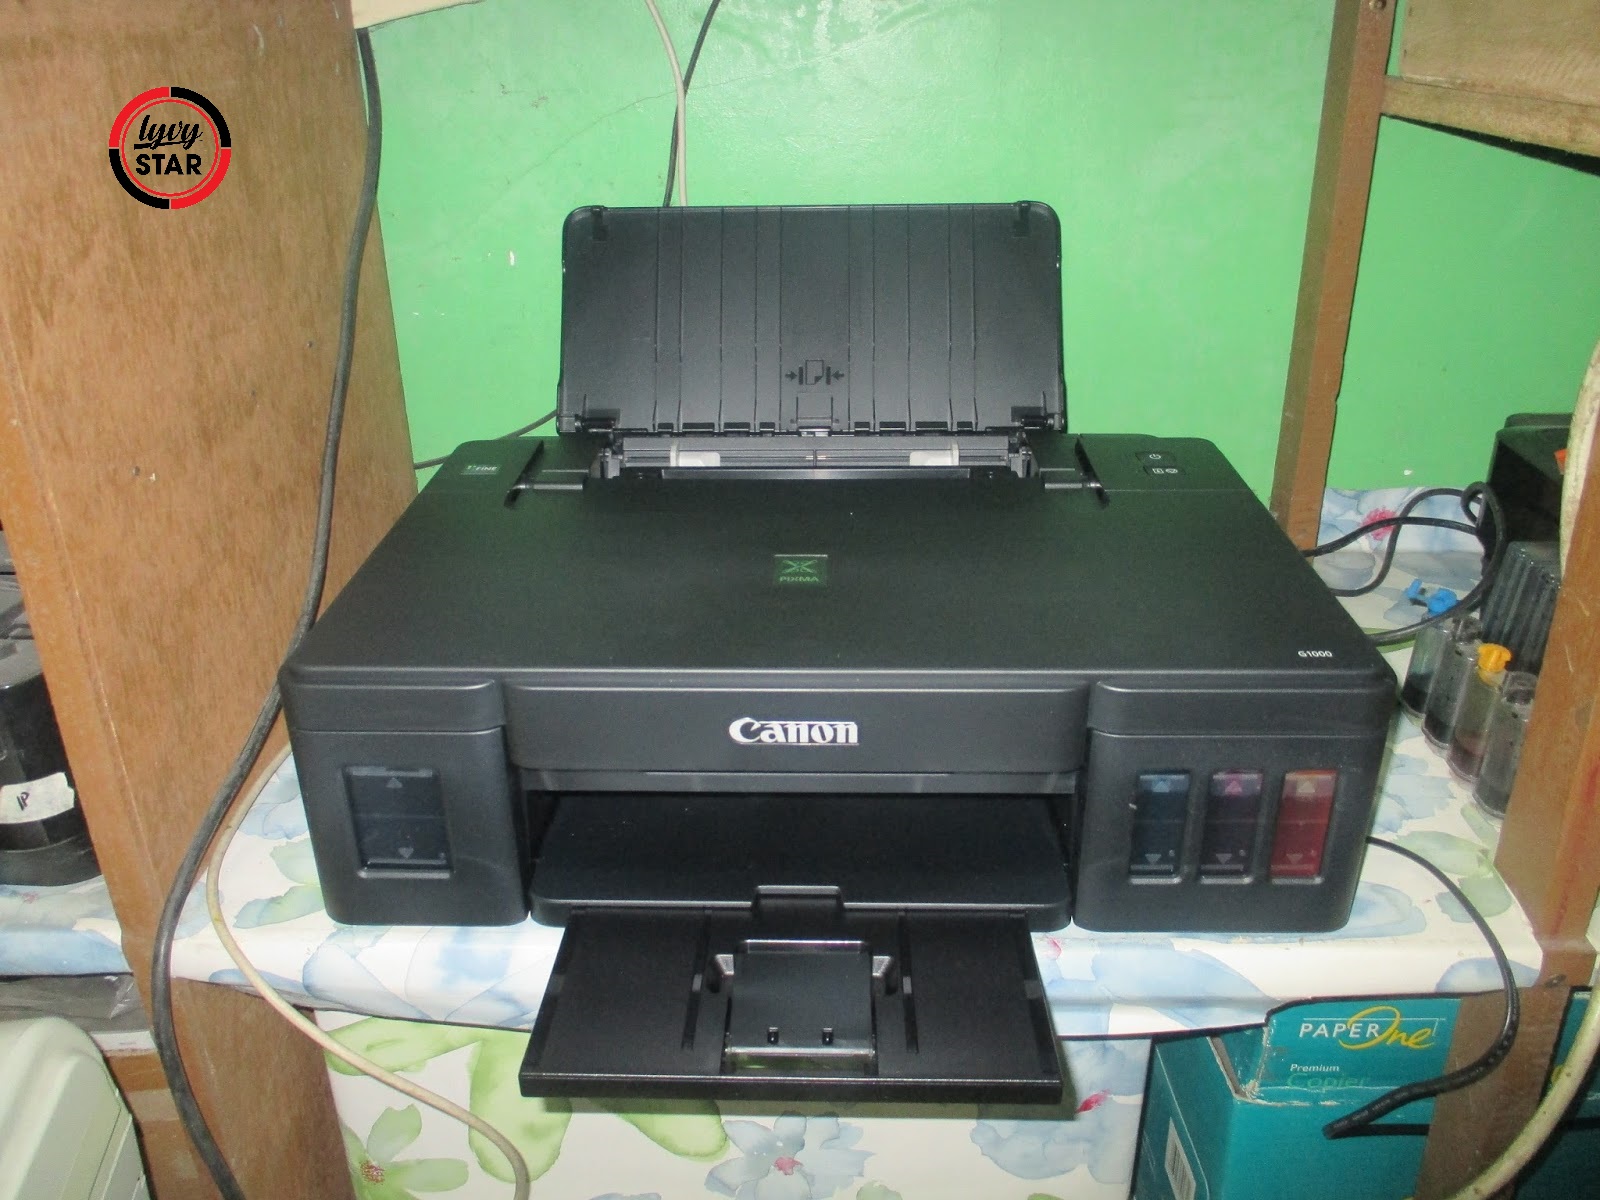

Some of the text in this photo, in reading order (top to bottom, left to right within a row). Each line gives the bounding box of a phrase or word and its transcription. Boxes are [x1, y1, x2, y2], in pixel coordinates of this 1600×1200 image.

[1297, 650, 1333, 658] G1000
[728, 717, 859, 744] Canon
[1299, 1005, 1436, 1050] PAPER One
[1290, 1063, 1340, 1073] Premium
[1286, 1073, 1371, 1093] Copier
